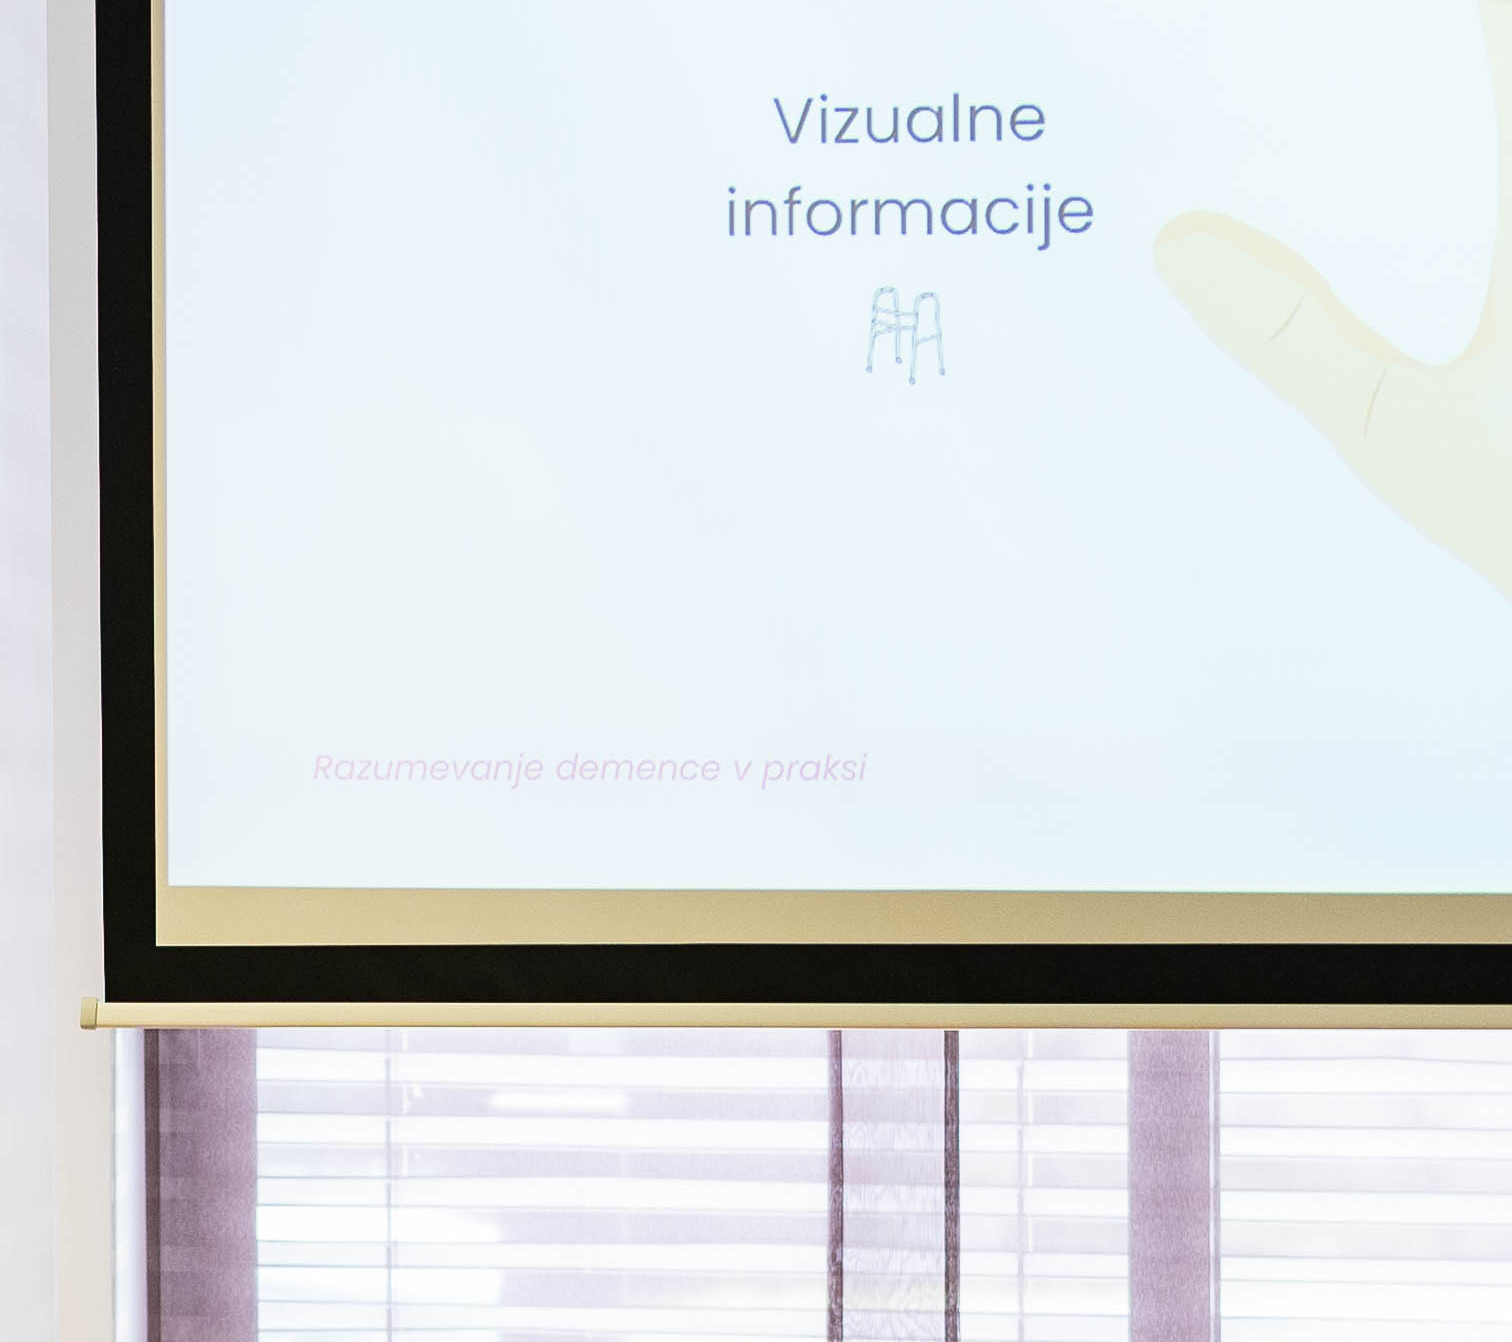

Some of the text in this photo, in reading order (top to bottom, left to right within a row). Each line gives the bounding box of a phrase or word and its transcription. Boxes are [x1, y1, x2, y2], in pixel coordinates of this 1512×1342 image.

[772, 91, 1046, 145] Vizualne
[727, 182, 1095, 252] informacije
[313, 753, 868, 791] Razumevanje demence v praksi
